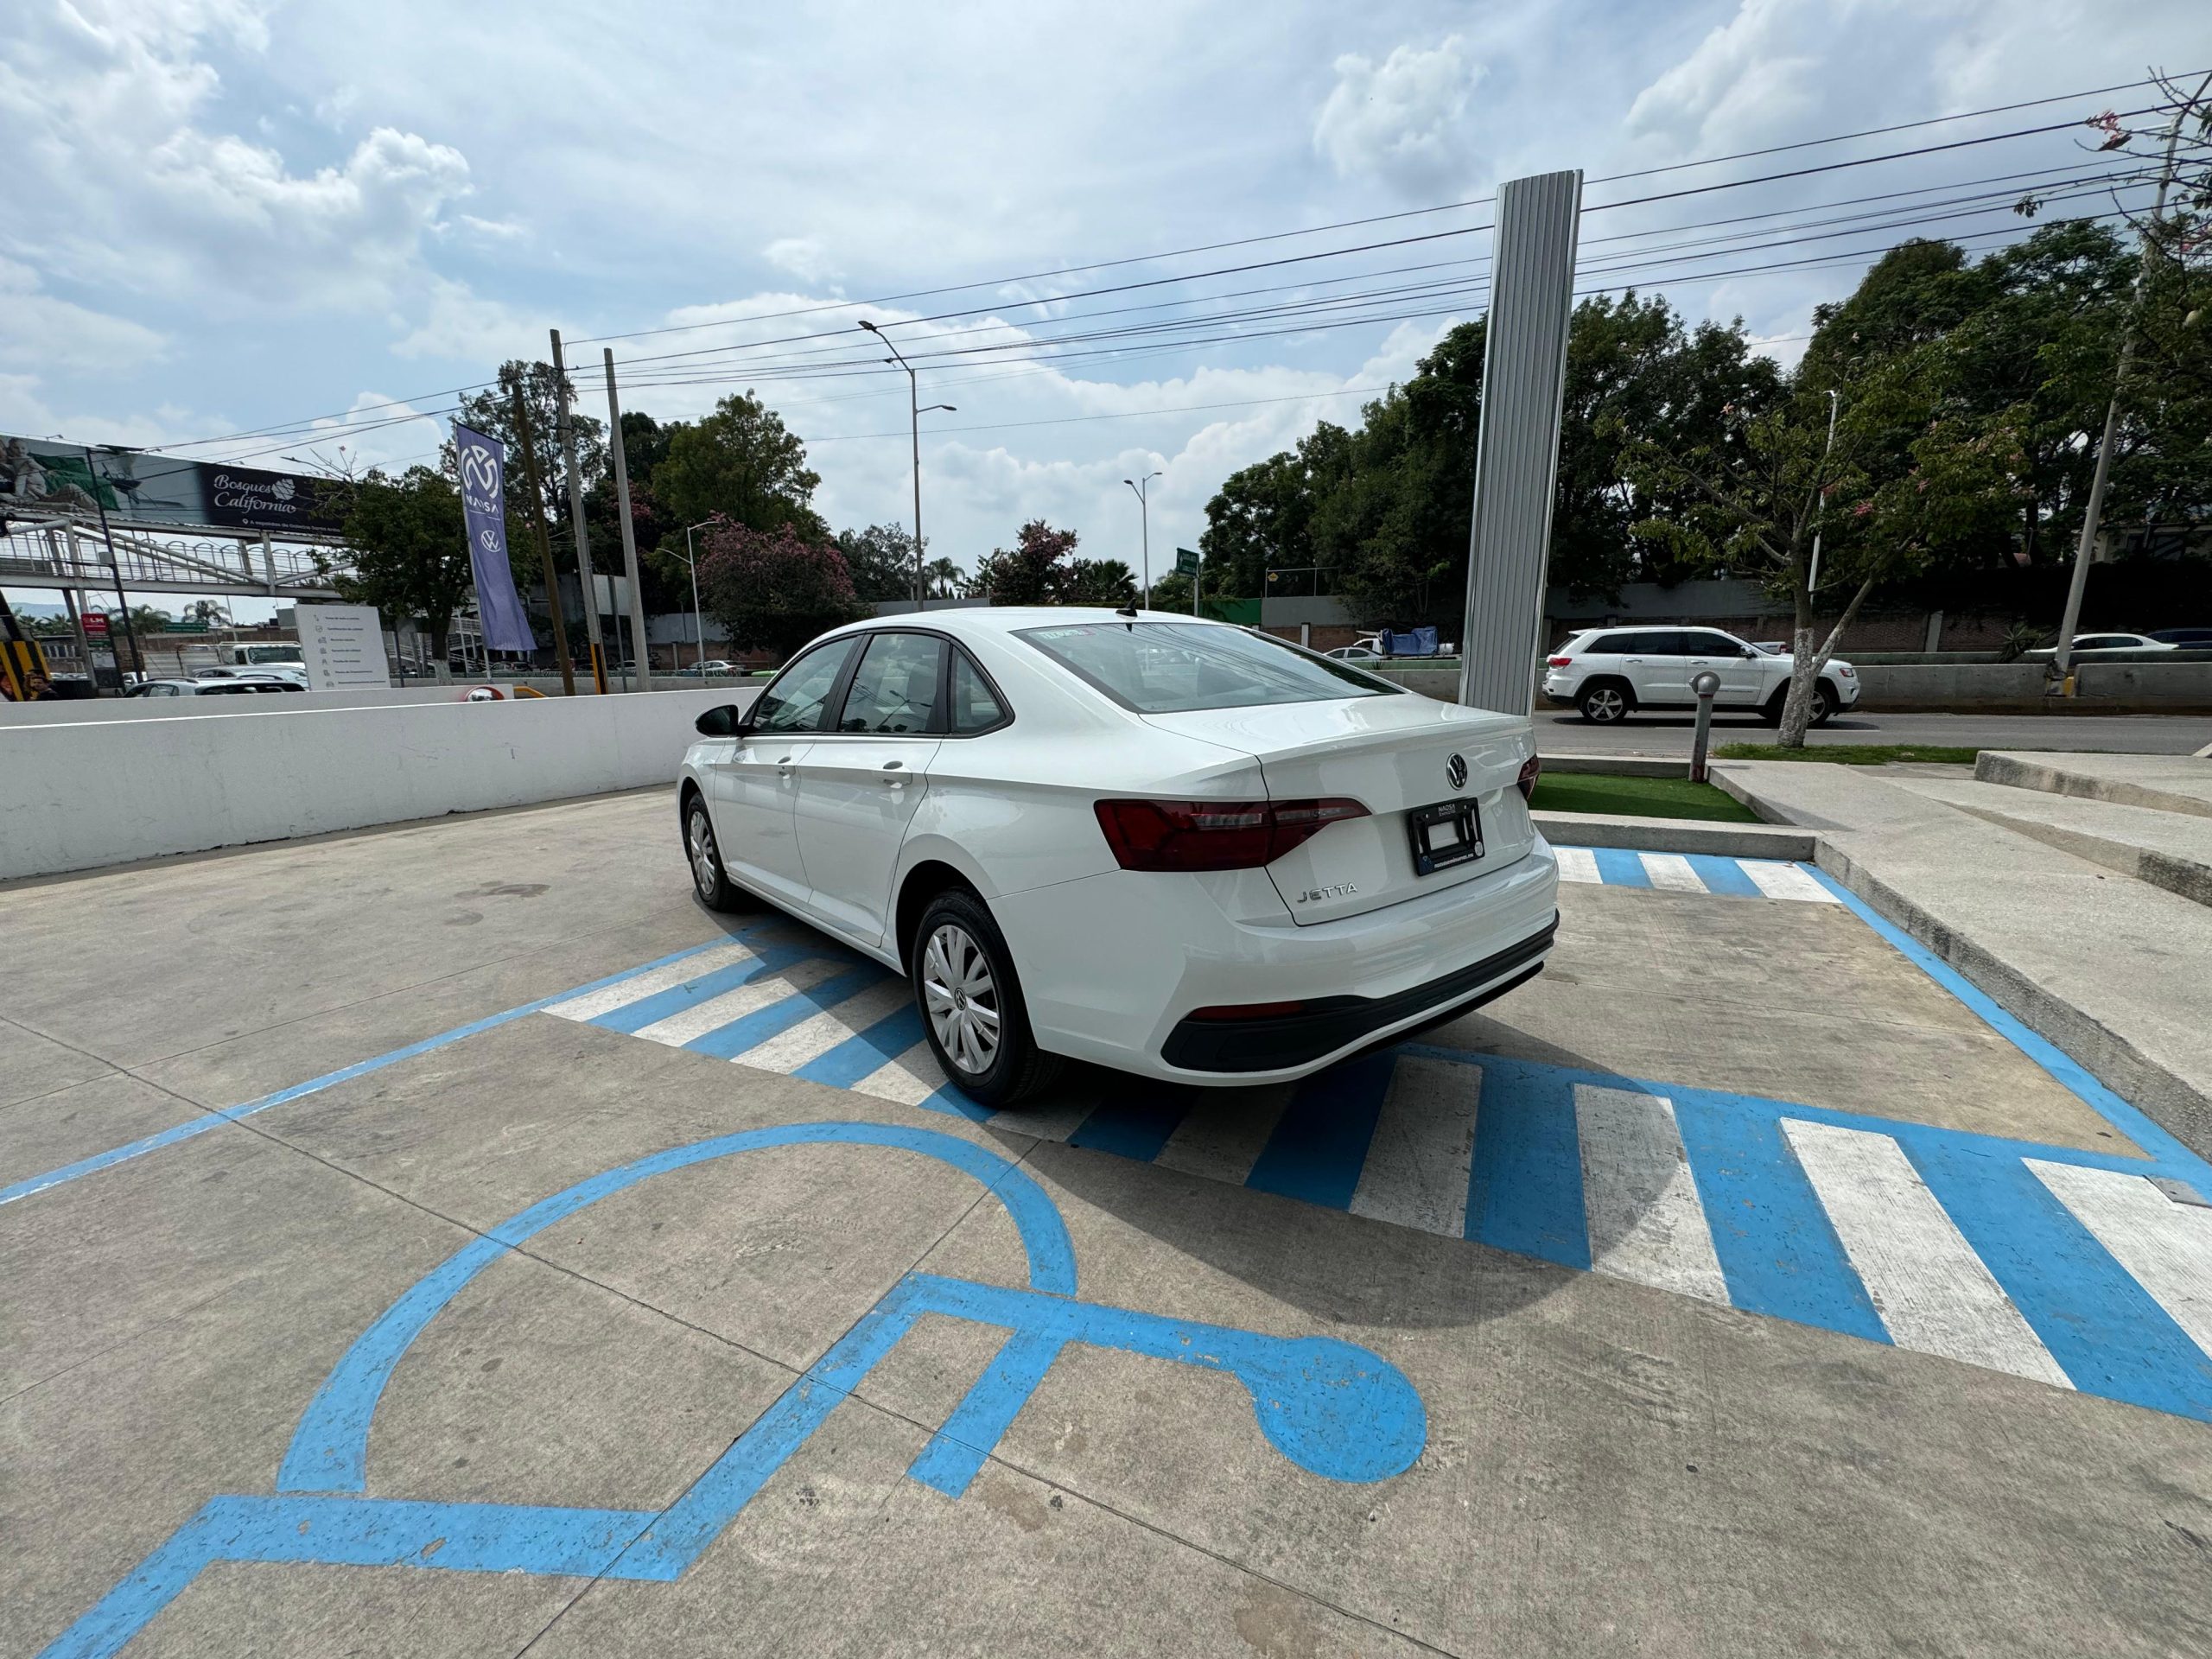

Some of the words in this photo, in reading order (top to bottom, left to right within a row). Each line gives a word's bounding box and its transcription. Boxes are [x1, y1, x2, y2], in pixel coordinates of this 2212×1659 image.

[213, 474, 272, 495] Bosques
[213, 492, 297, 514] California
[1296, 881, 1358, 903] JETTA
